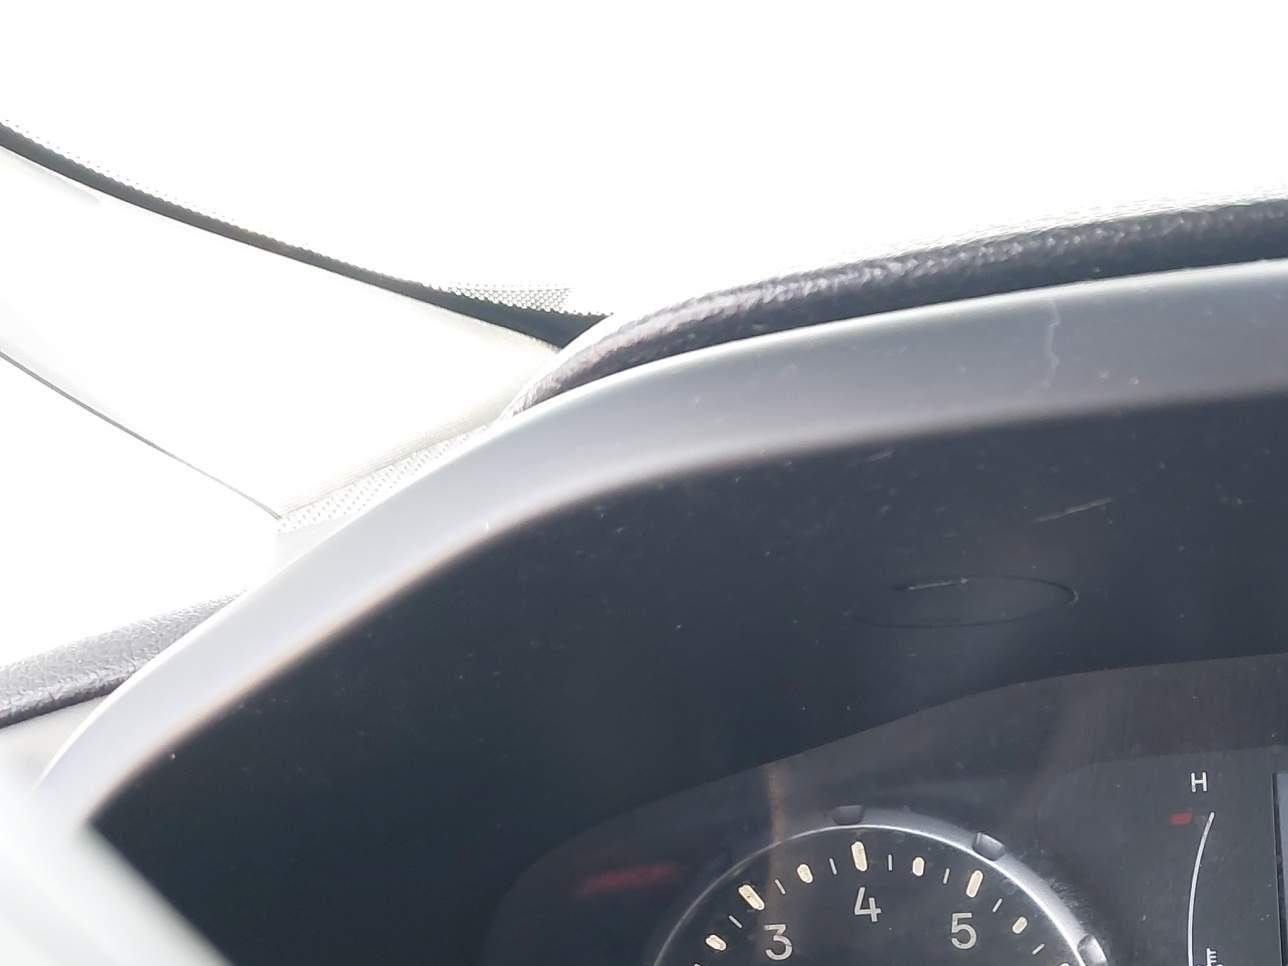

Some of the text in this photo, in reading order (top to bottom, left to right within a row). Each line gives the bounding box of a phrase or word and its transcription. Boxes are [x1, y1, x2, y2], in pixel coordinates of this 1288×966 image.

[1191, 772, 1206, 792] H
[855, 887, 881, 921] 4
[765, 924, 792, 960] 3
[952, 913, 976, 949] 5
